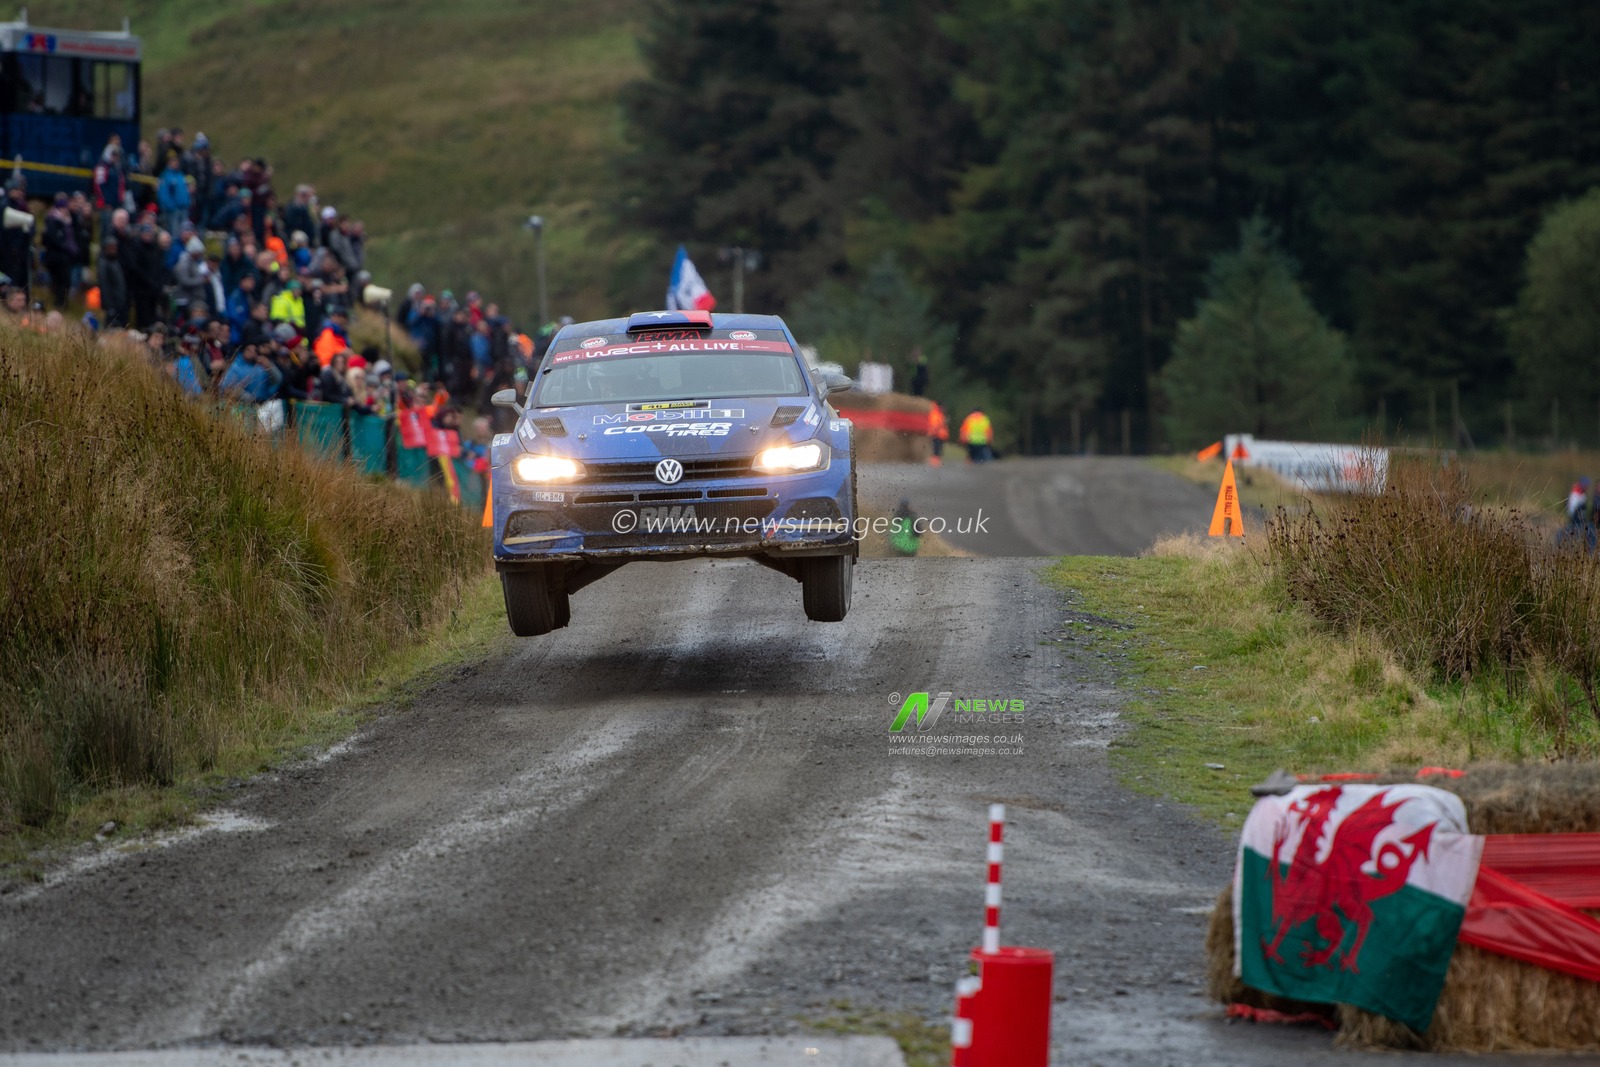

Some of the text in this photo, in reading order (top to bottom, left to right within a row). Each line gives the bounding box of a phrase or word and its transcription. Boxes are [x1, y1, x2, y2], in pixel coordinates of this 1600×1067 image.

[669, 343, 700, 351] ALL
[704, 342, 739, 350] LIVE
[603, 422, 733, 435] COOPER
[666, 429, 730, 437] TIRES
